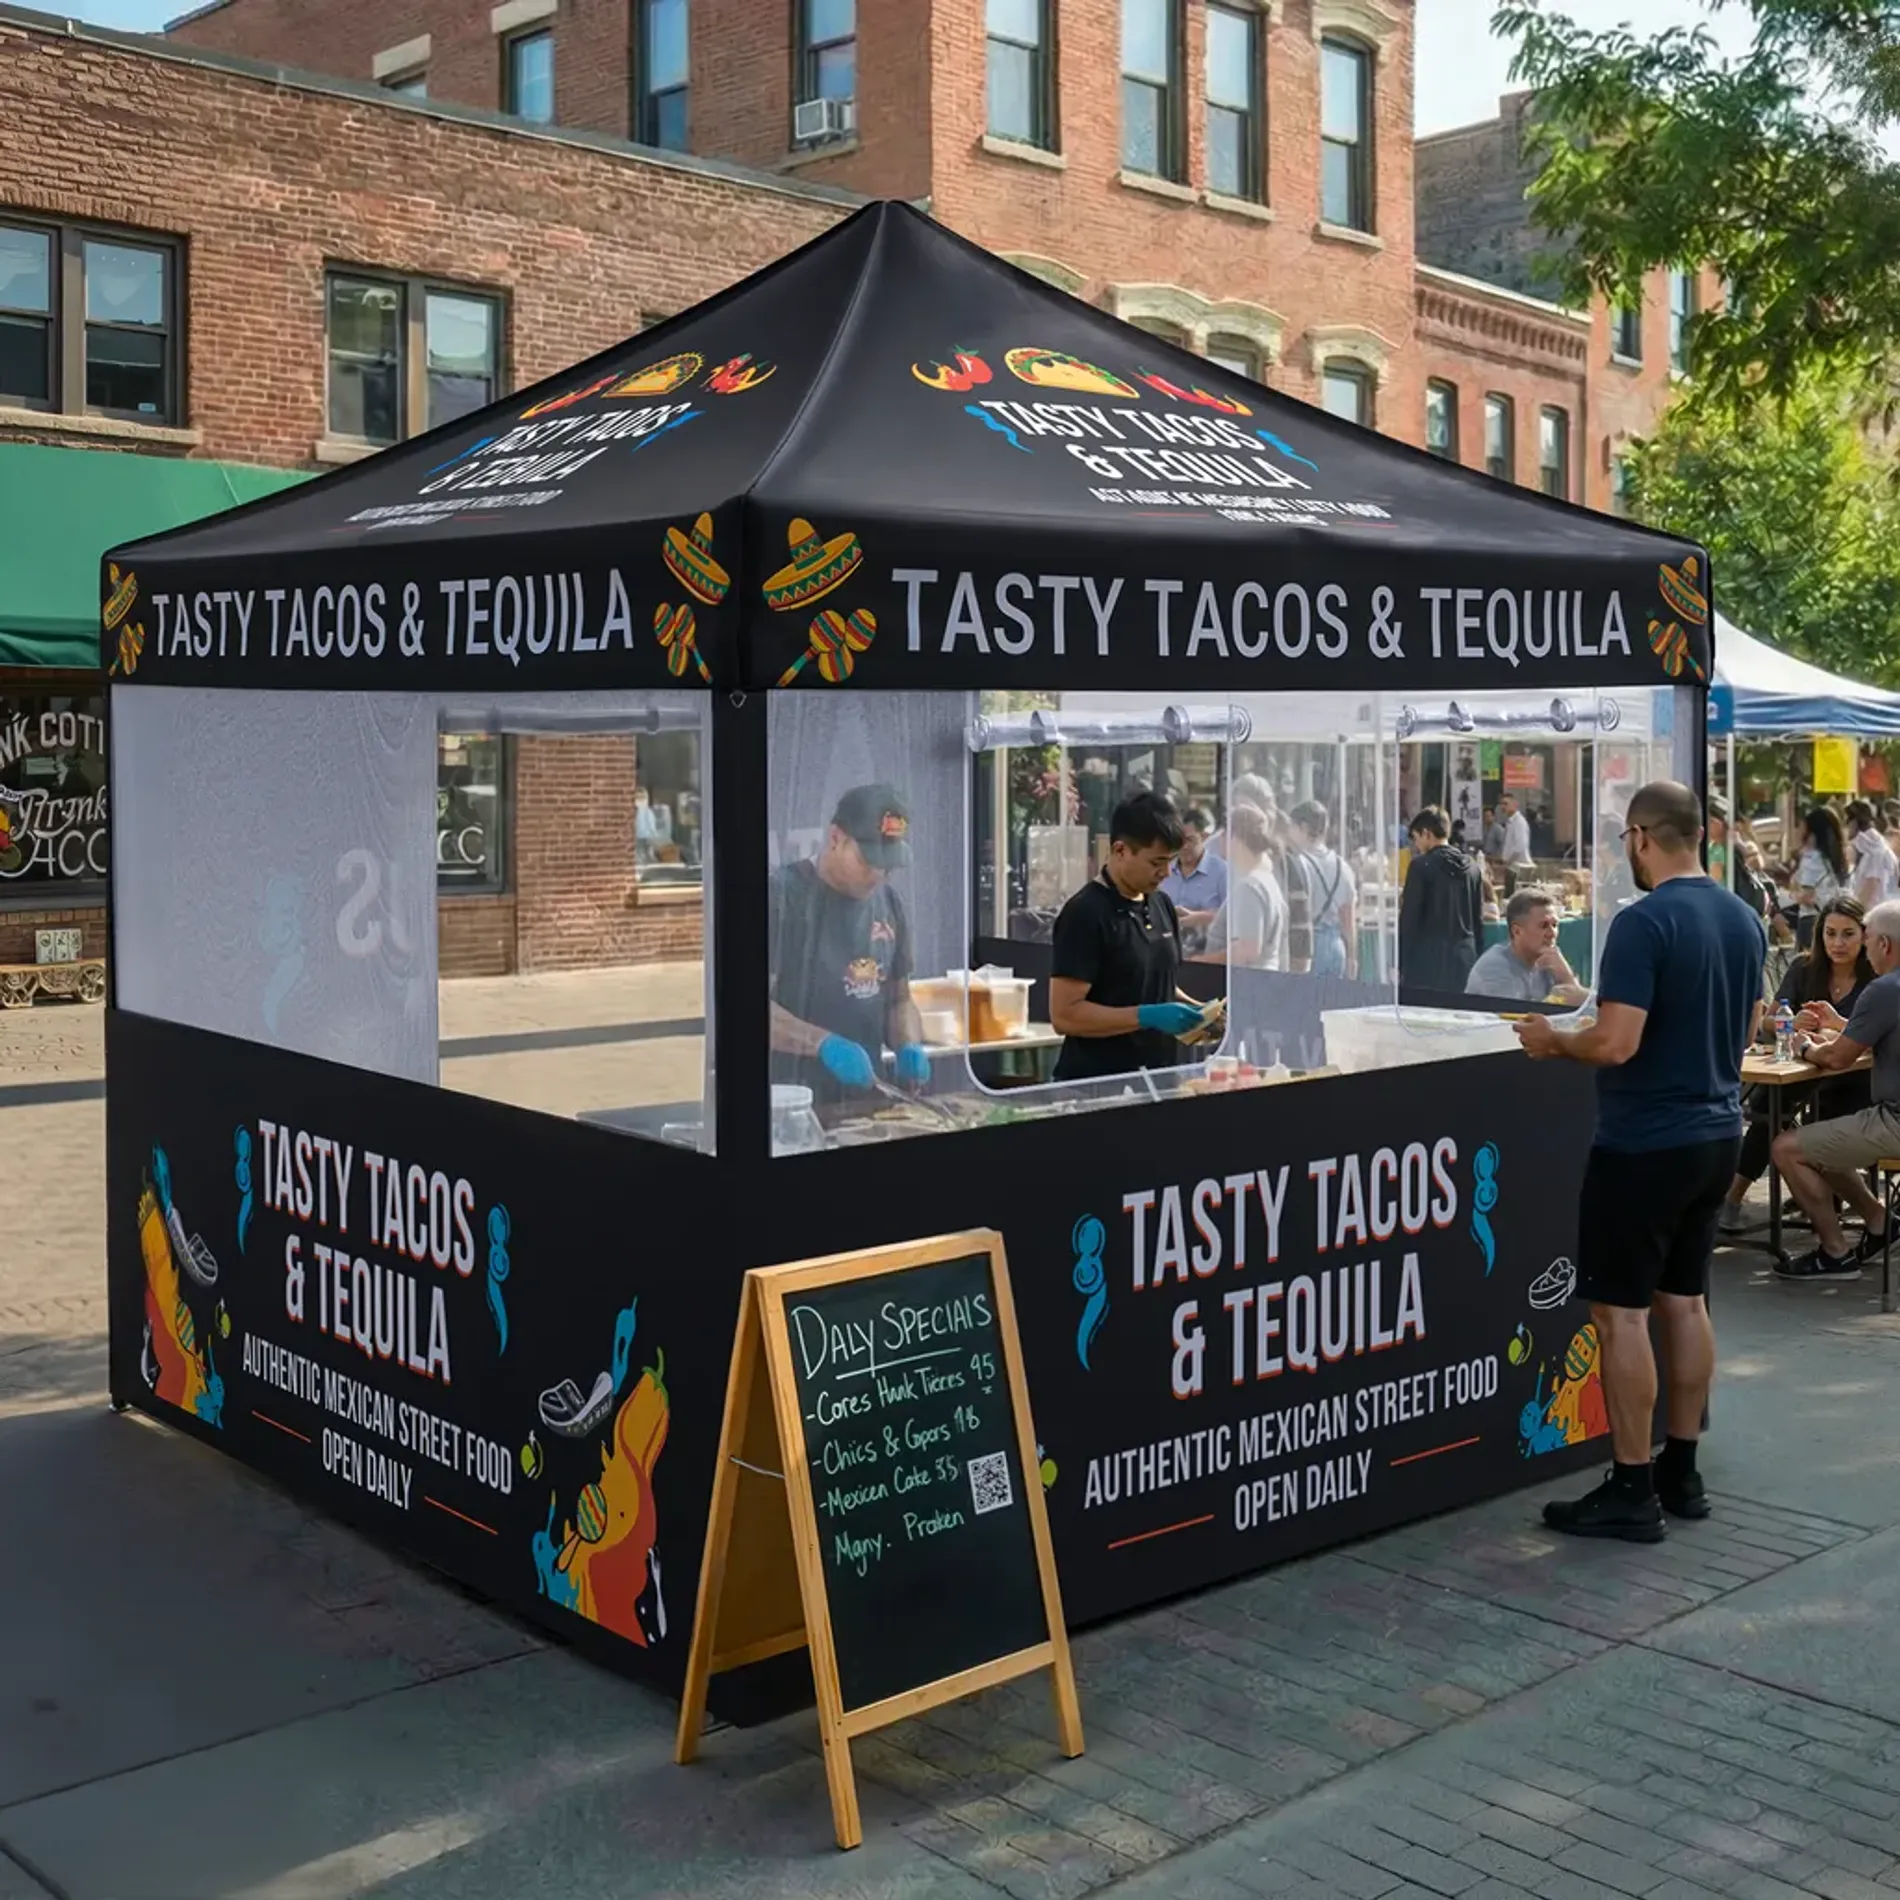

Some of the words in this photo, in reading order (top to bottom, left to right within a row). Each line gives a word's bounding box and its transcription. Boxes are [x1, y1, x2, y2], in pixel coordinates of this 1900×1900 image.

[979, 401, 1127, 439] TASTY
[1112, 408, 1266, 451] TACOS
[1065, 444, 1123, 479] &
[1101, 445, 1312, 490] TEQUILA
[152, 590, 255, 657] TASTY
[265, 583, 386, 657] TACOS
[399, 582, 425, 657] &
[440, 568, 634, 667] TEQUILA
[892, 568, 1124, 656] TASTY
[1145, 579, 1348, 659] TACOS
[1367, 585, 1405, 659] &
[1419, 588, 1631, 667] TEQUILA
[259, 1119, 353, 1233] TASTY
[364, 1151, 475, 1278] TACOS
[1122, 1165, 1290, 1292] TASTY
[1308, 1136, 1458, 1253] TACOS
[285, 1234, 305, 1323] &
[314, 1242, 451, 1386] TEQUILA
[1171, 1300, 1206, 1400] &
[1223, 1252, 1426, 1386] TEQUILA
[242, 1332, 321, 1405] AUTHENTIC
[324, 1368, 394, 1440] MEXICAN
[399, 1402, 461, 1471] STREET
[466, 1432, 512, 1495] FOOD
[883, 1425, 900, 1457] &
[1083, 1424, 1232, 1509] AUTHENTIC
[1238, 1396, 1348, 1466] MEXICAN
[1354, 1369, 1438, 1434] STREET
[1444, 1354, 1499, 1409] FOOD
[322, 1427, 362, 1488] OPEN
[367, 1447, 413, 1511] DAILY
[1234, 1470, 1298, 1531] OPEN
[1306, 1448, 1372, 1512] DAILY
